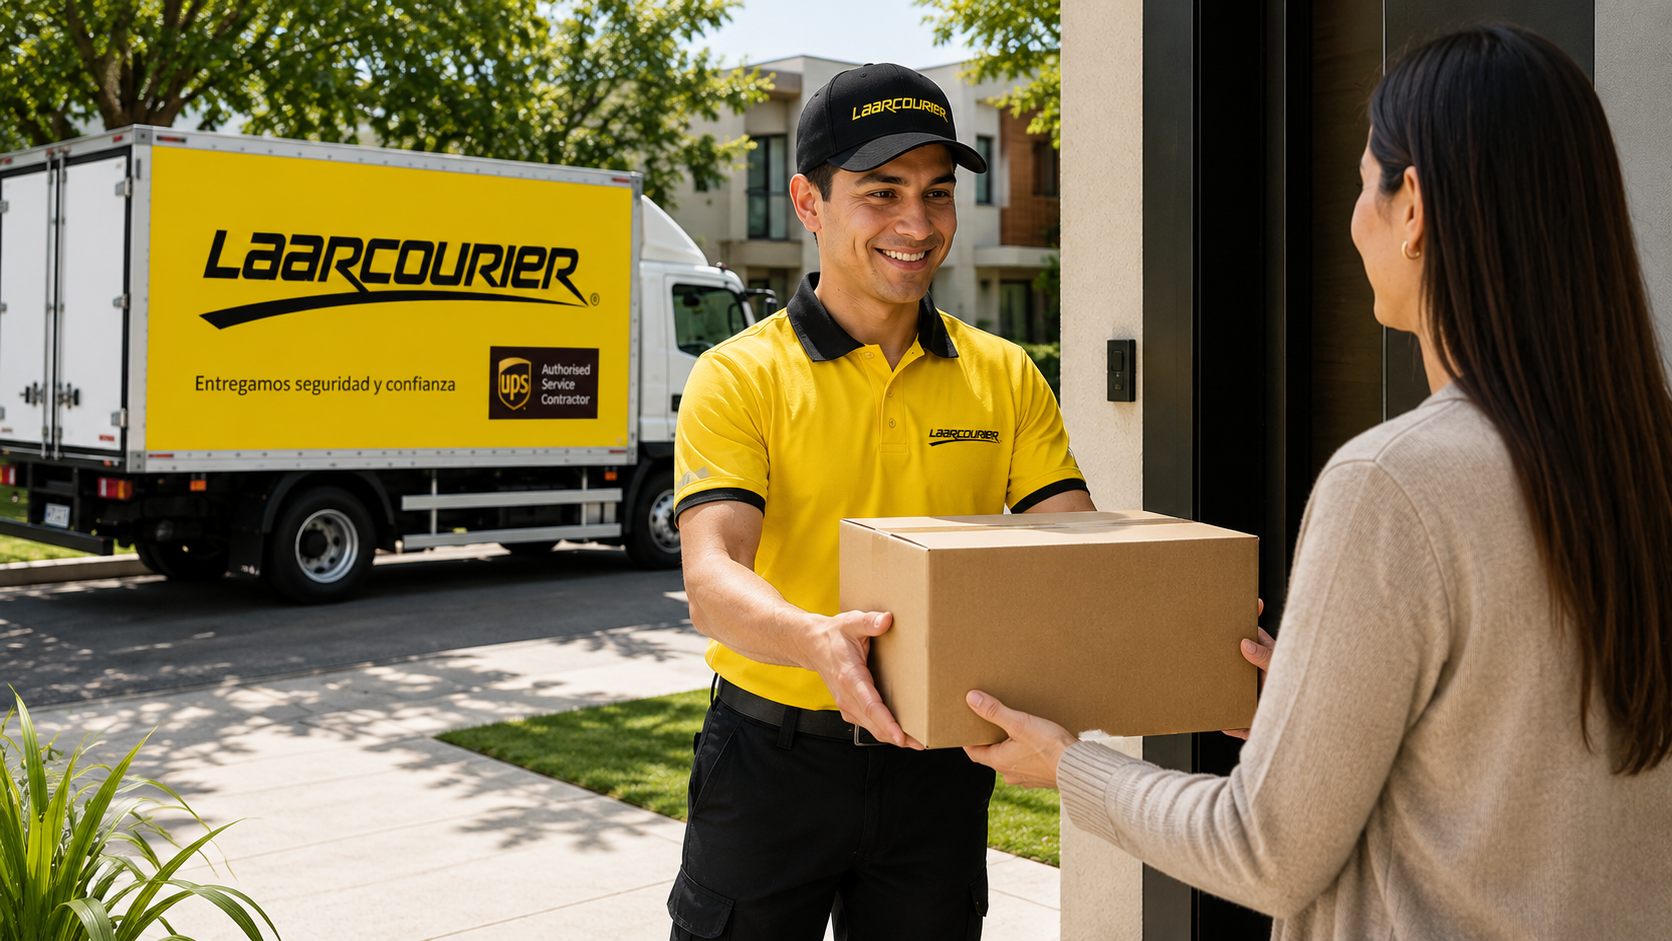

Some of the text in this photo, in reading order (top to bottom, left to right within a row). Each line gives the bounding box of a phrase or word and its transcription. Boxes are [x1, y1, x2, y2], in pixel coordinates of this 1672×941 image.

[541, 363, 591, 376] Authorised
[195, 375, 456, 396] Entregamos seguridad y confianza
[501, 374, 529, 401] ups
[541, 378, 576, 391] Service
[541, 393, 591, 406] Contractor
